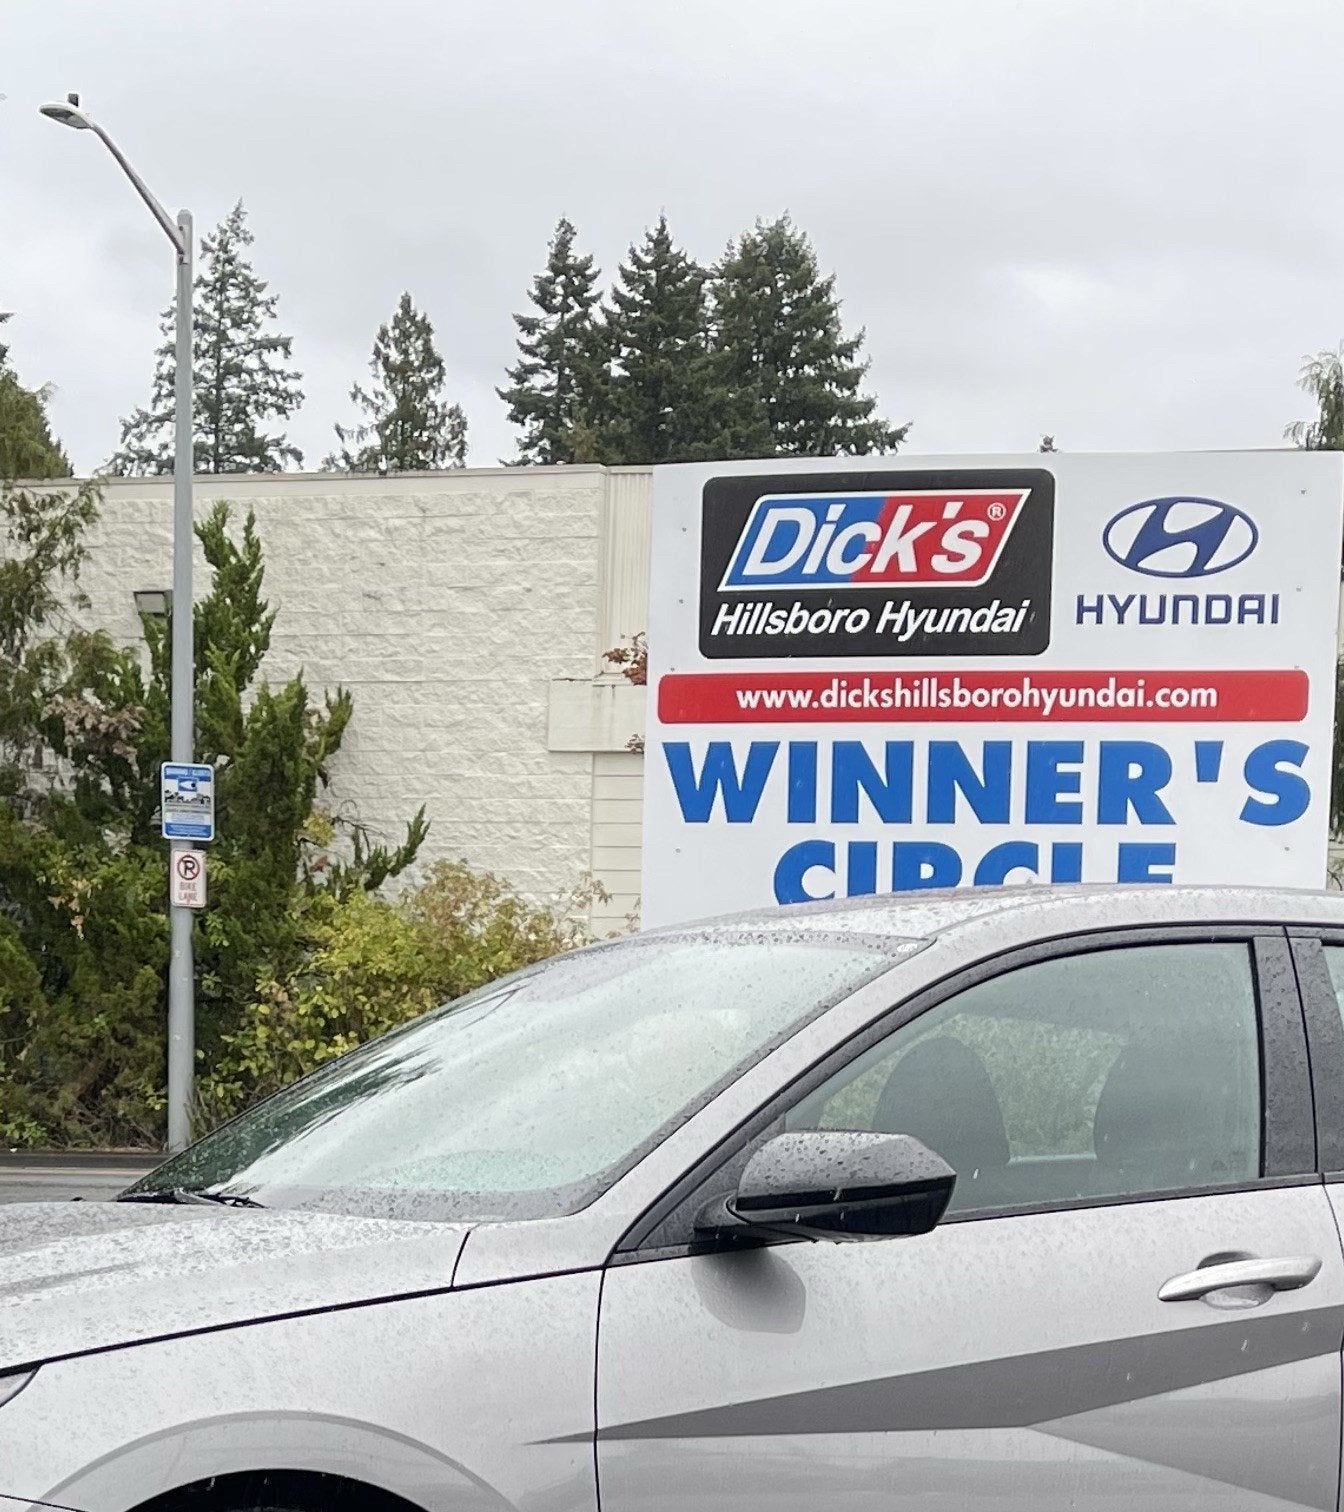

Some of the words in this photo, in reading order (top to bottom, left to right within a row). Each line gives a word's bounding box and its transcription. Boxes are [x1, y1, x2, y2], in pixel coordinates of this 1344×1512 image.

[710, 600, 870, 637] Hillsboro
[875, 599, 1032, 644] Hyundai
[1075, 593, 1280, 626] HYUNDAI
[735, 679, 1218, 716] www.dickshillsborohyundai.com
[662, 739, 1312, 827] WINNER'S
